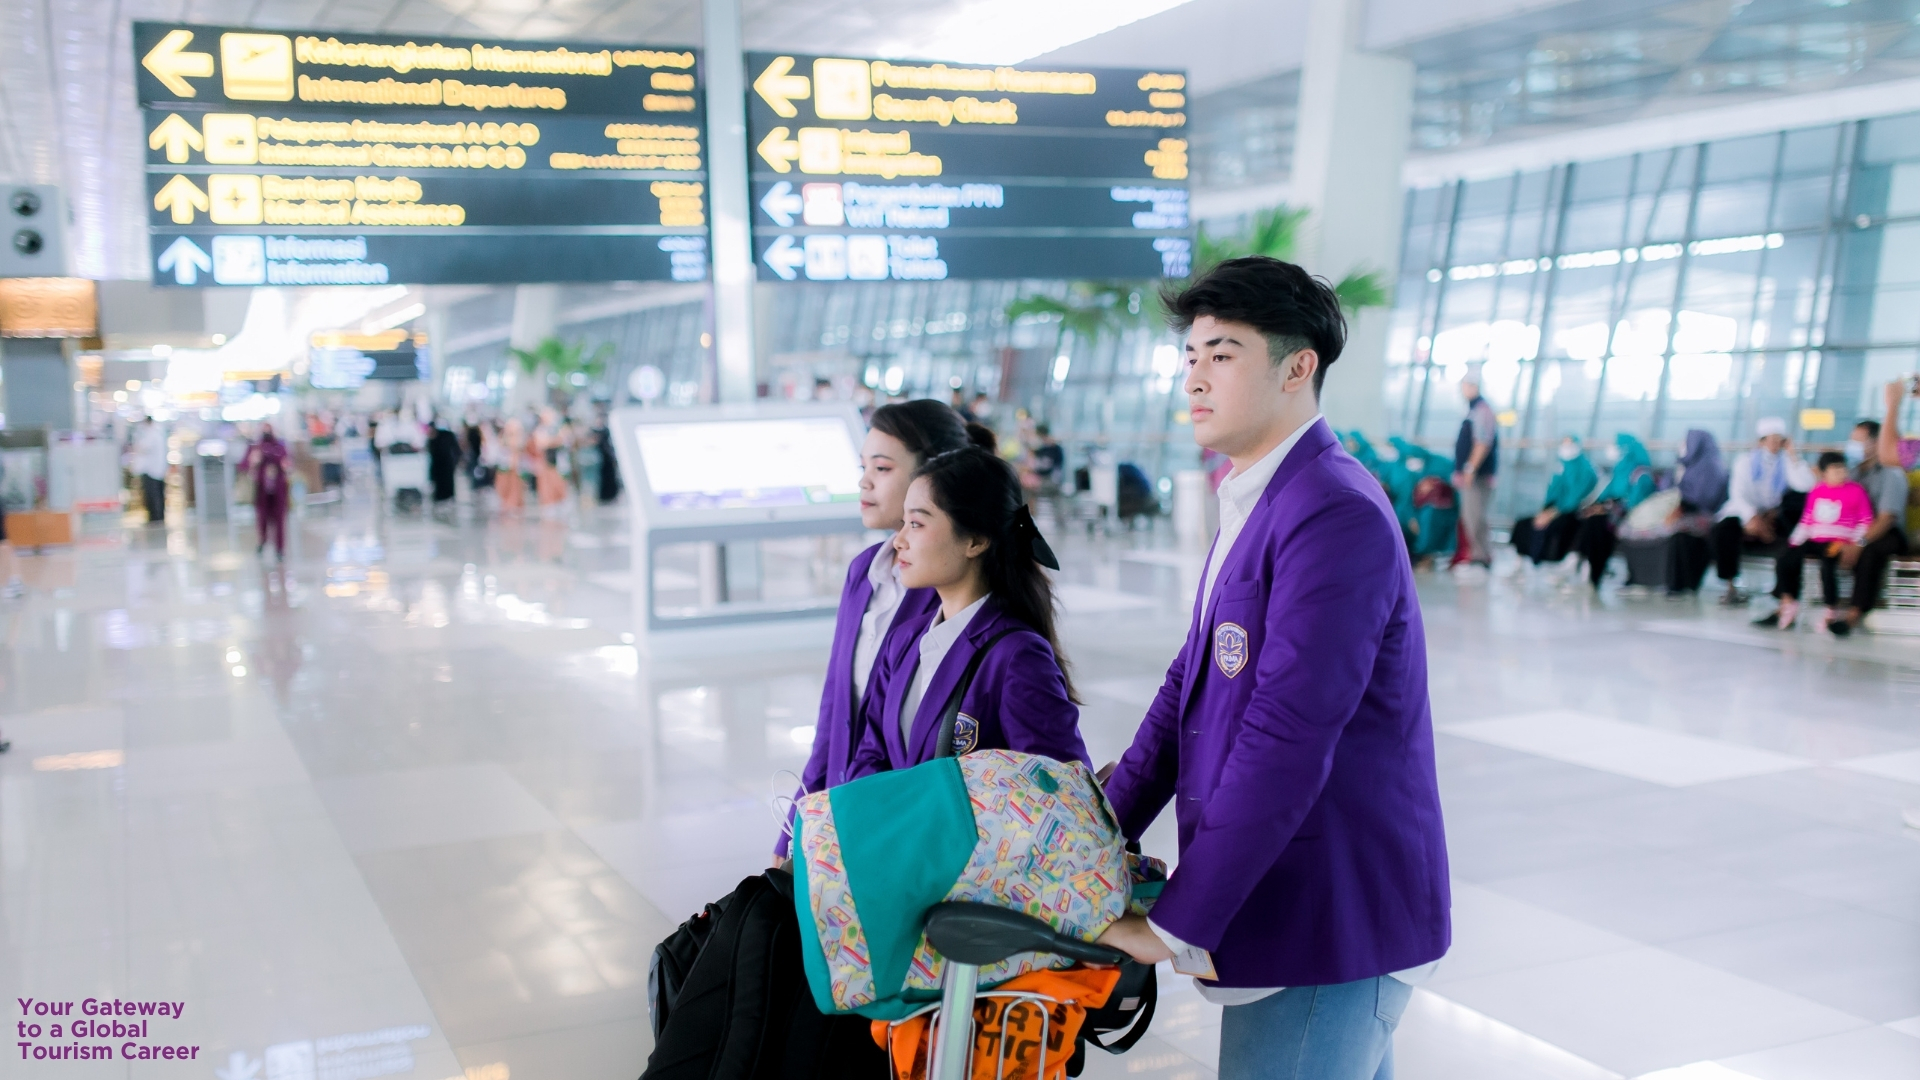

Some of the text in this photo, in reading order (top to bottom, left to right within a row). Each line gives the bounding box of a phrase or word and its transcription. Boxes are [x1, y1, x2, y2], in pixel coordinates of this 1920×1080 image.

[298, 75, 442, 106] International
[267, 260, 389, 284] Information
[979, 999, 1068, 1037] ORTS
[981, 1030, 1065, 1062] TION
